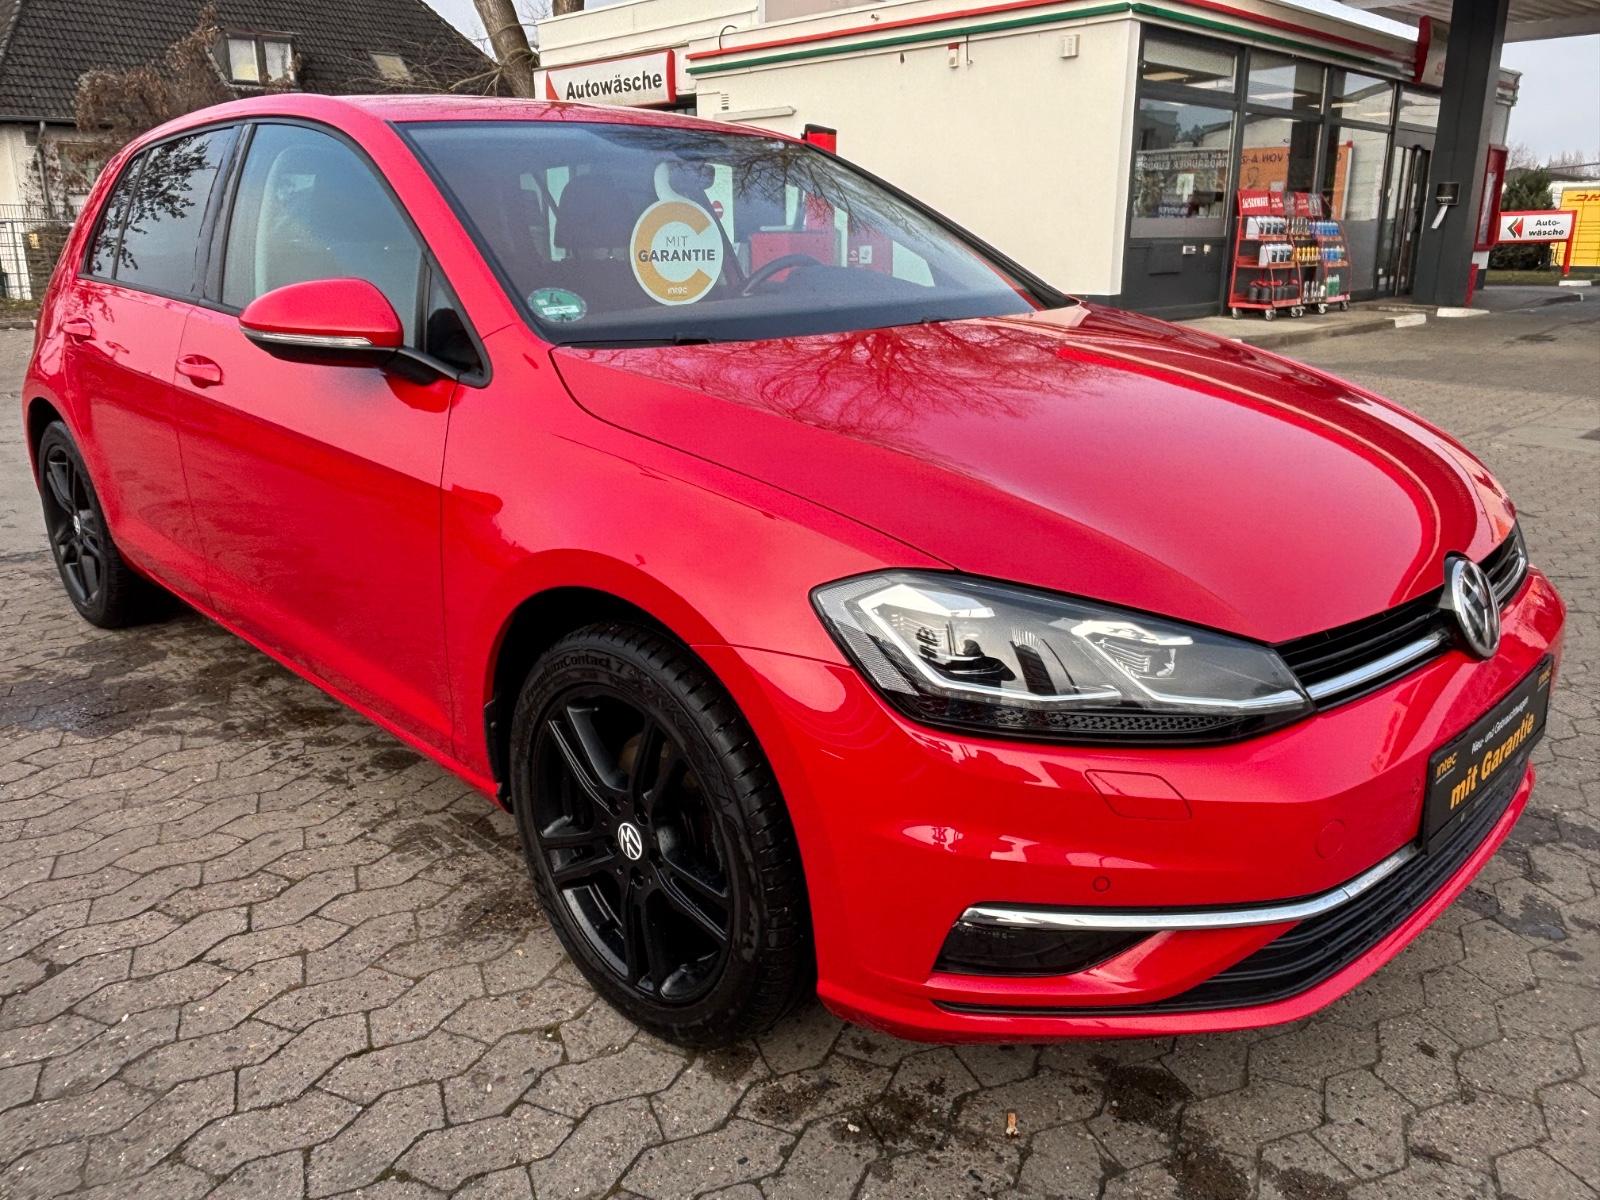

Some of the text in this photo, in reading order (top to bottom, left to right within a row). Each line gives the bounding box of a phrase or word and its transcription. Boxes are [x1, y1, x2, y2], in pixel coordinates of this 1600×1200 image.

[566, 70, 662, 100] Autowäsche
[1528, 228, 1564, 236] wäsche
[666, 236, 688, 247] MIT
[638, 249, 716, 262] GARANTIE
[1450, 712, 1535, 810] mit Garantie
